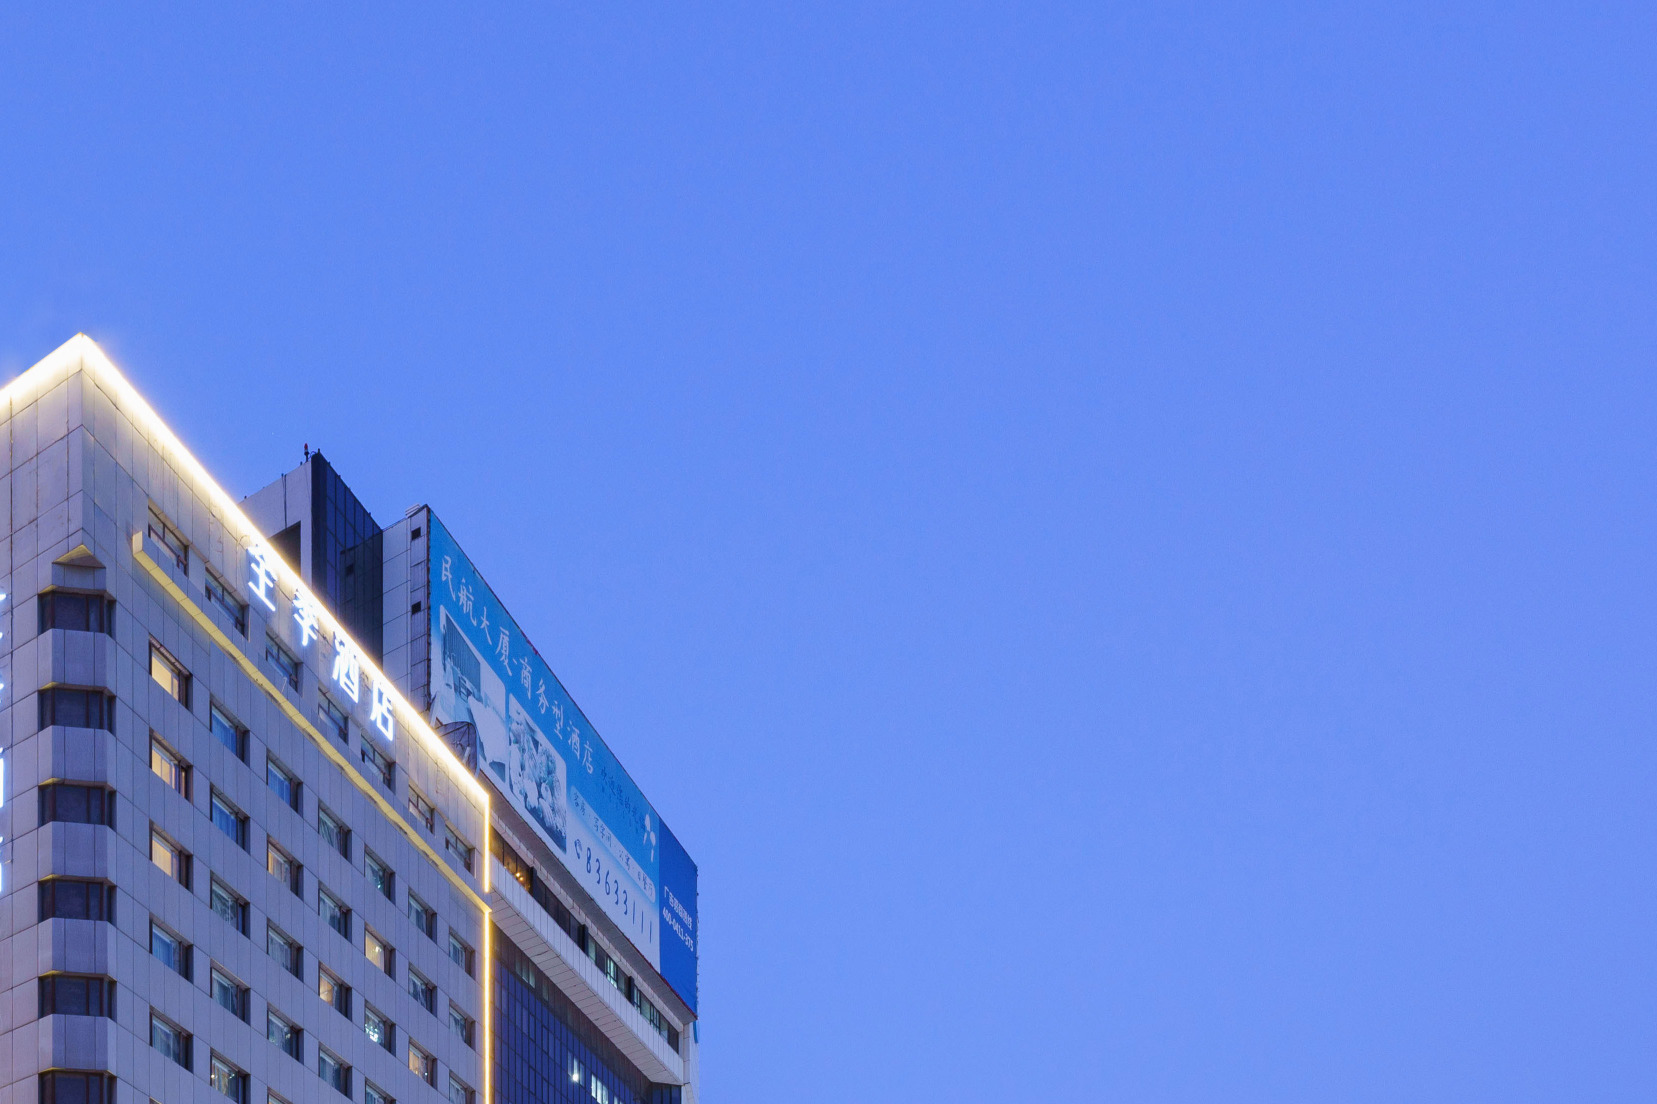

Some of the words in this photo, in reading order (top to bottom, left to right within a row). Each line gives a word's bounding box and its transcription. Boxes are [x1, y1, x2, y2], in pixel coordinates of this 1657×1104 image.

[247, 545, 394, 742] 全季酒店
[586, 846, 653, 944] 83633111
